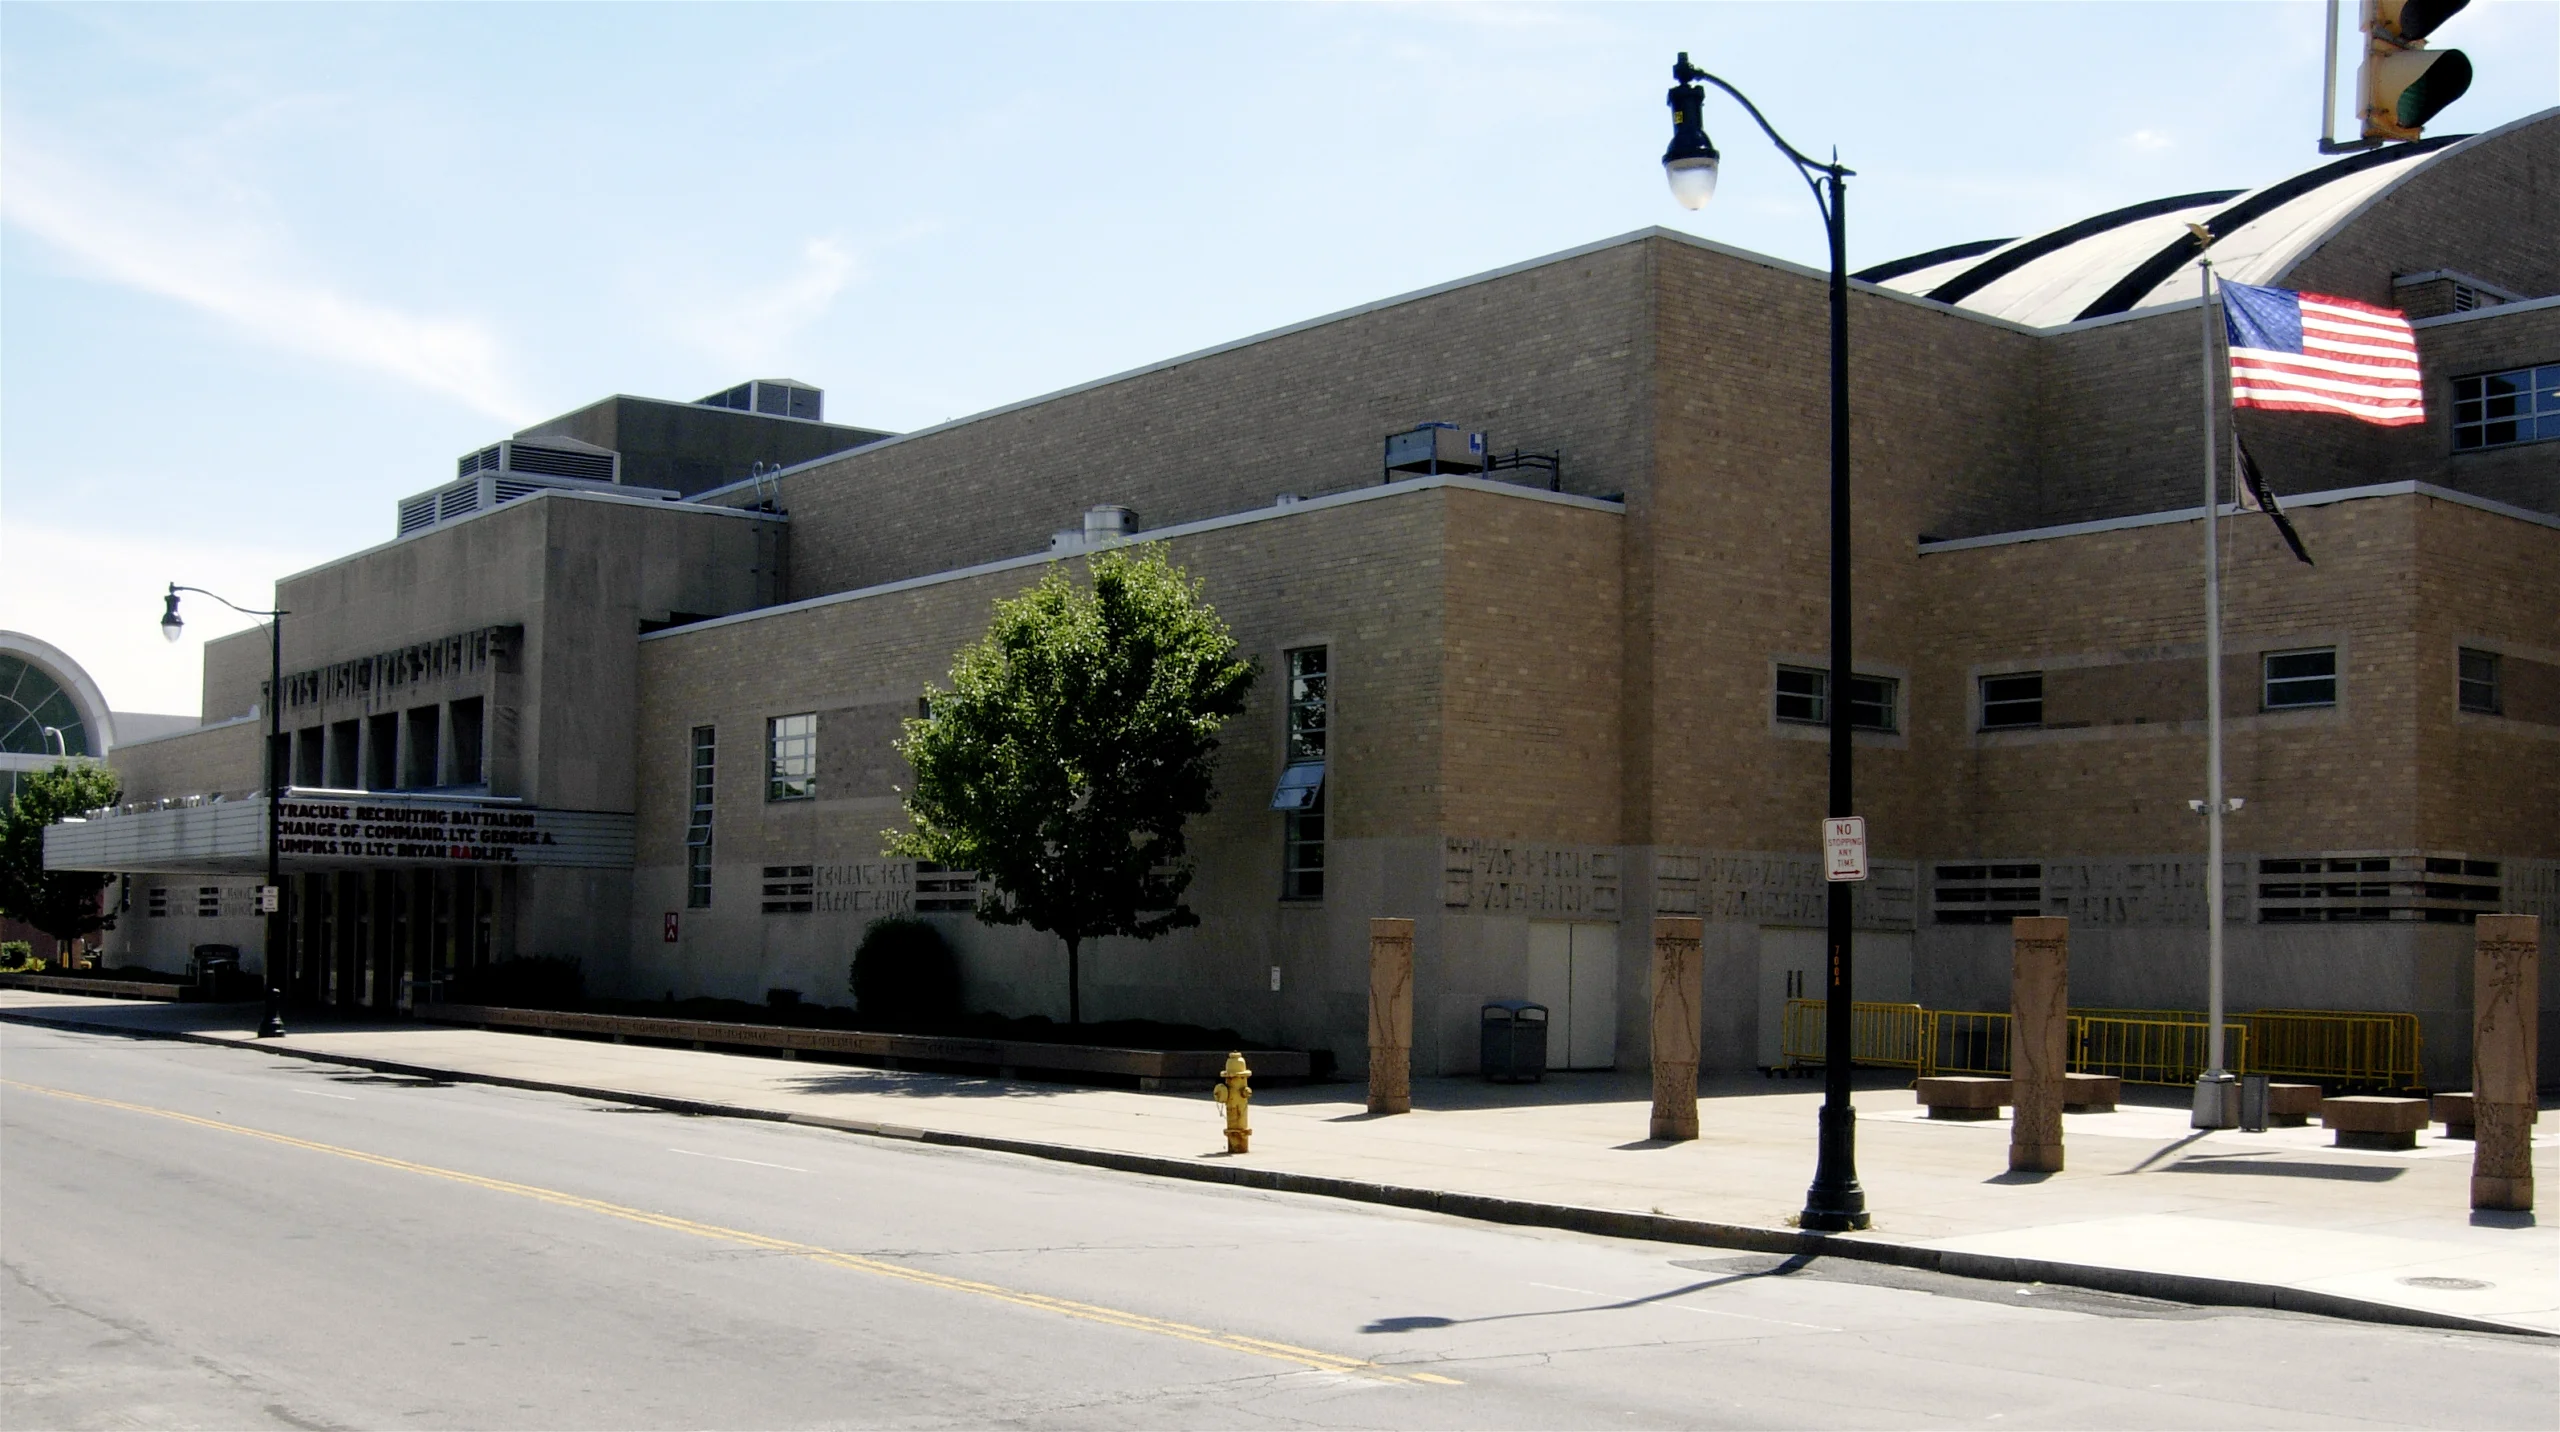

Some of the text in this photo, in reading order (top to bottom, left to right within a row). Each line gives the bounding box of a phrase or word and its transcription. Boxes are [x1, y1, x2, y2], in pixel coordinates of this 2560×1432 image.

[278, 804, 535, 828] YRACUSE RECRUITING BATTALION
[340, 824, 360, 838] OF
[449, 828, 476, 843] LTC
[480, 829, 539, 845] GEORGE
[542, 832, 557, 845] A.
[1836, 824, 1852, 835] NO
[278, 839, 338, 855] UMPIKS
[341, 841, 362, 855] TO
[366, 842, 394, 856] LTC
[397, 844, 446, 858] BRYAN
[1828, 838, 1862, 846] STOPPING
[1837, 859, 1855, 867] TIME
